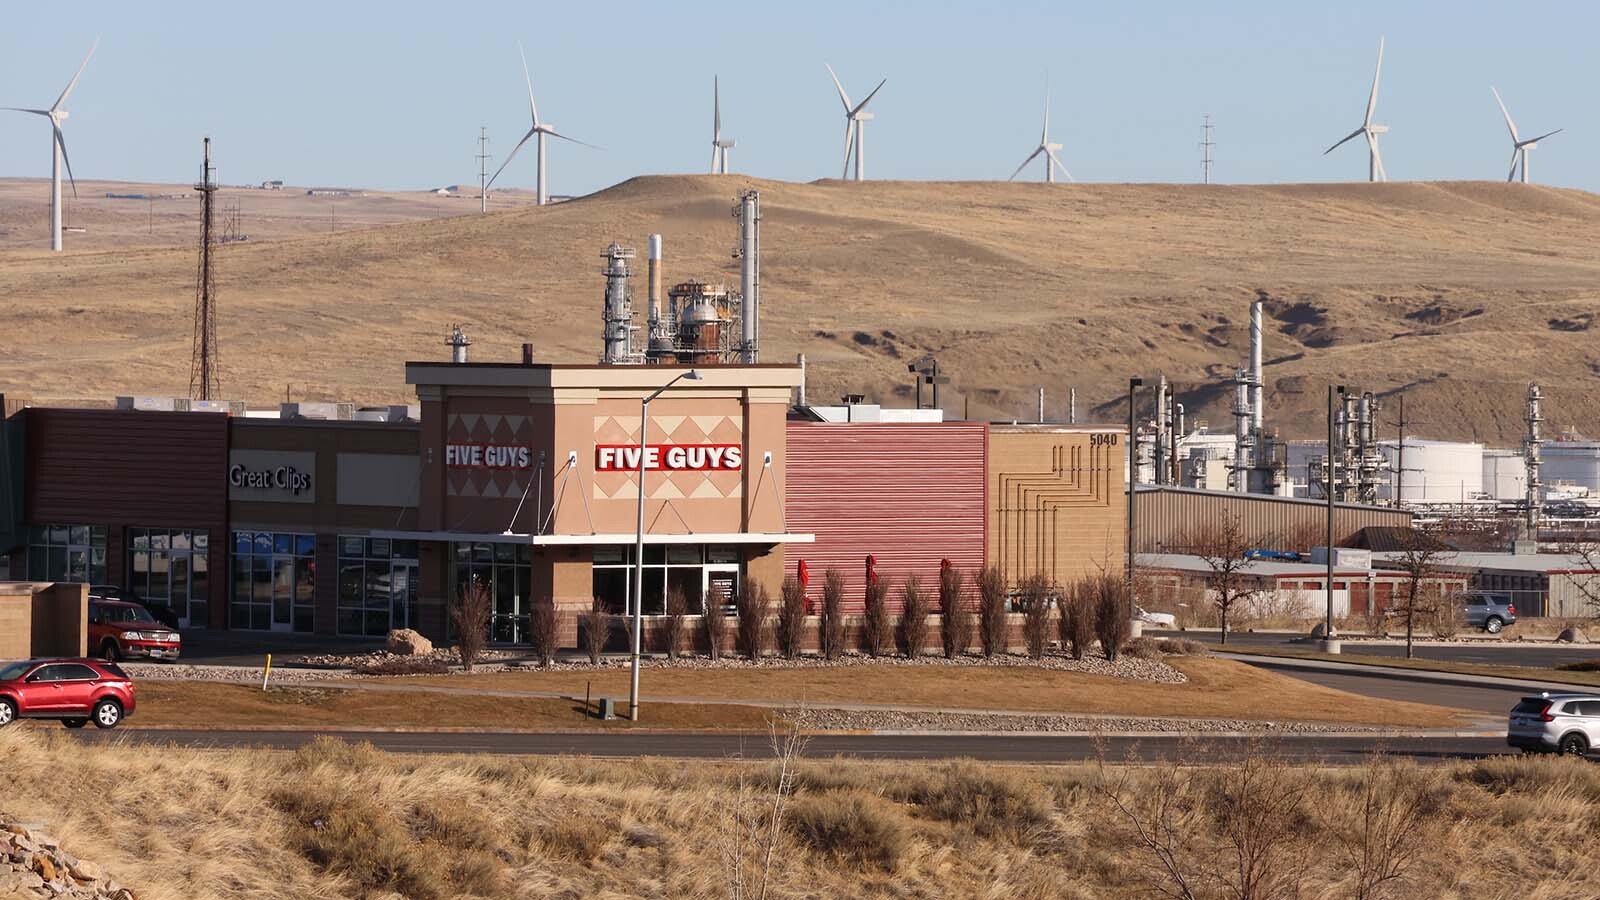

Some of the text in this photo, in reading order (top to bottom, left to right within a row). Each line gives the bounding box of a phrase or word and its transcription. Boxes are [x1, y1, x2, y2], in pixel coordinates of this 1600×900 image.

[1090, 433, 1117, 446] 5040
[446, 445, 529, 468] FIVE GUYS
[598, 446, 742, 469] FIVE GUYS
[229, 464, 309, 497] Great Clips
